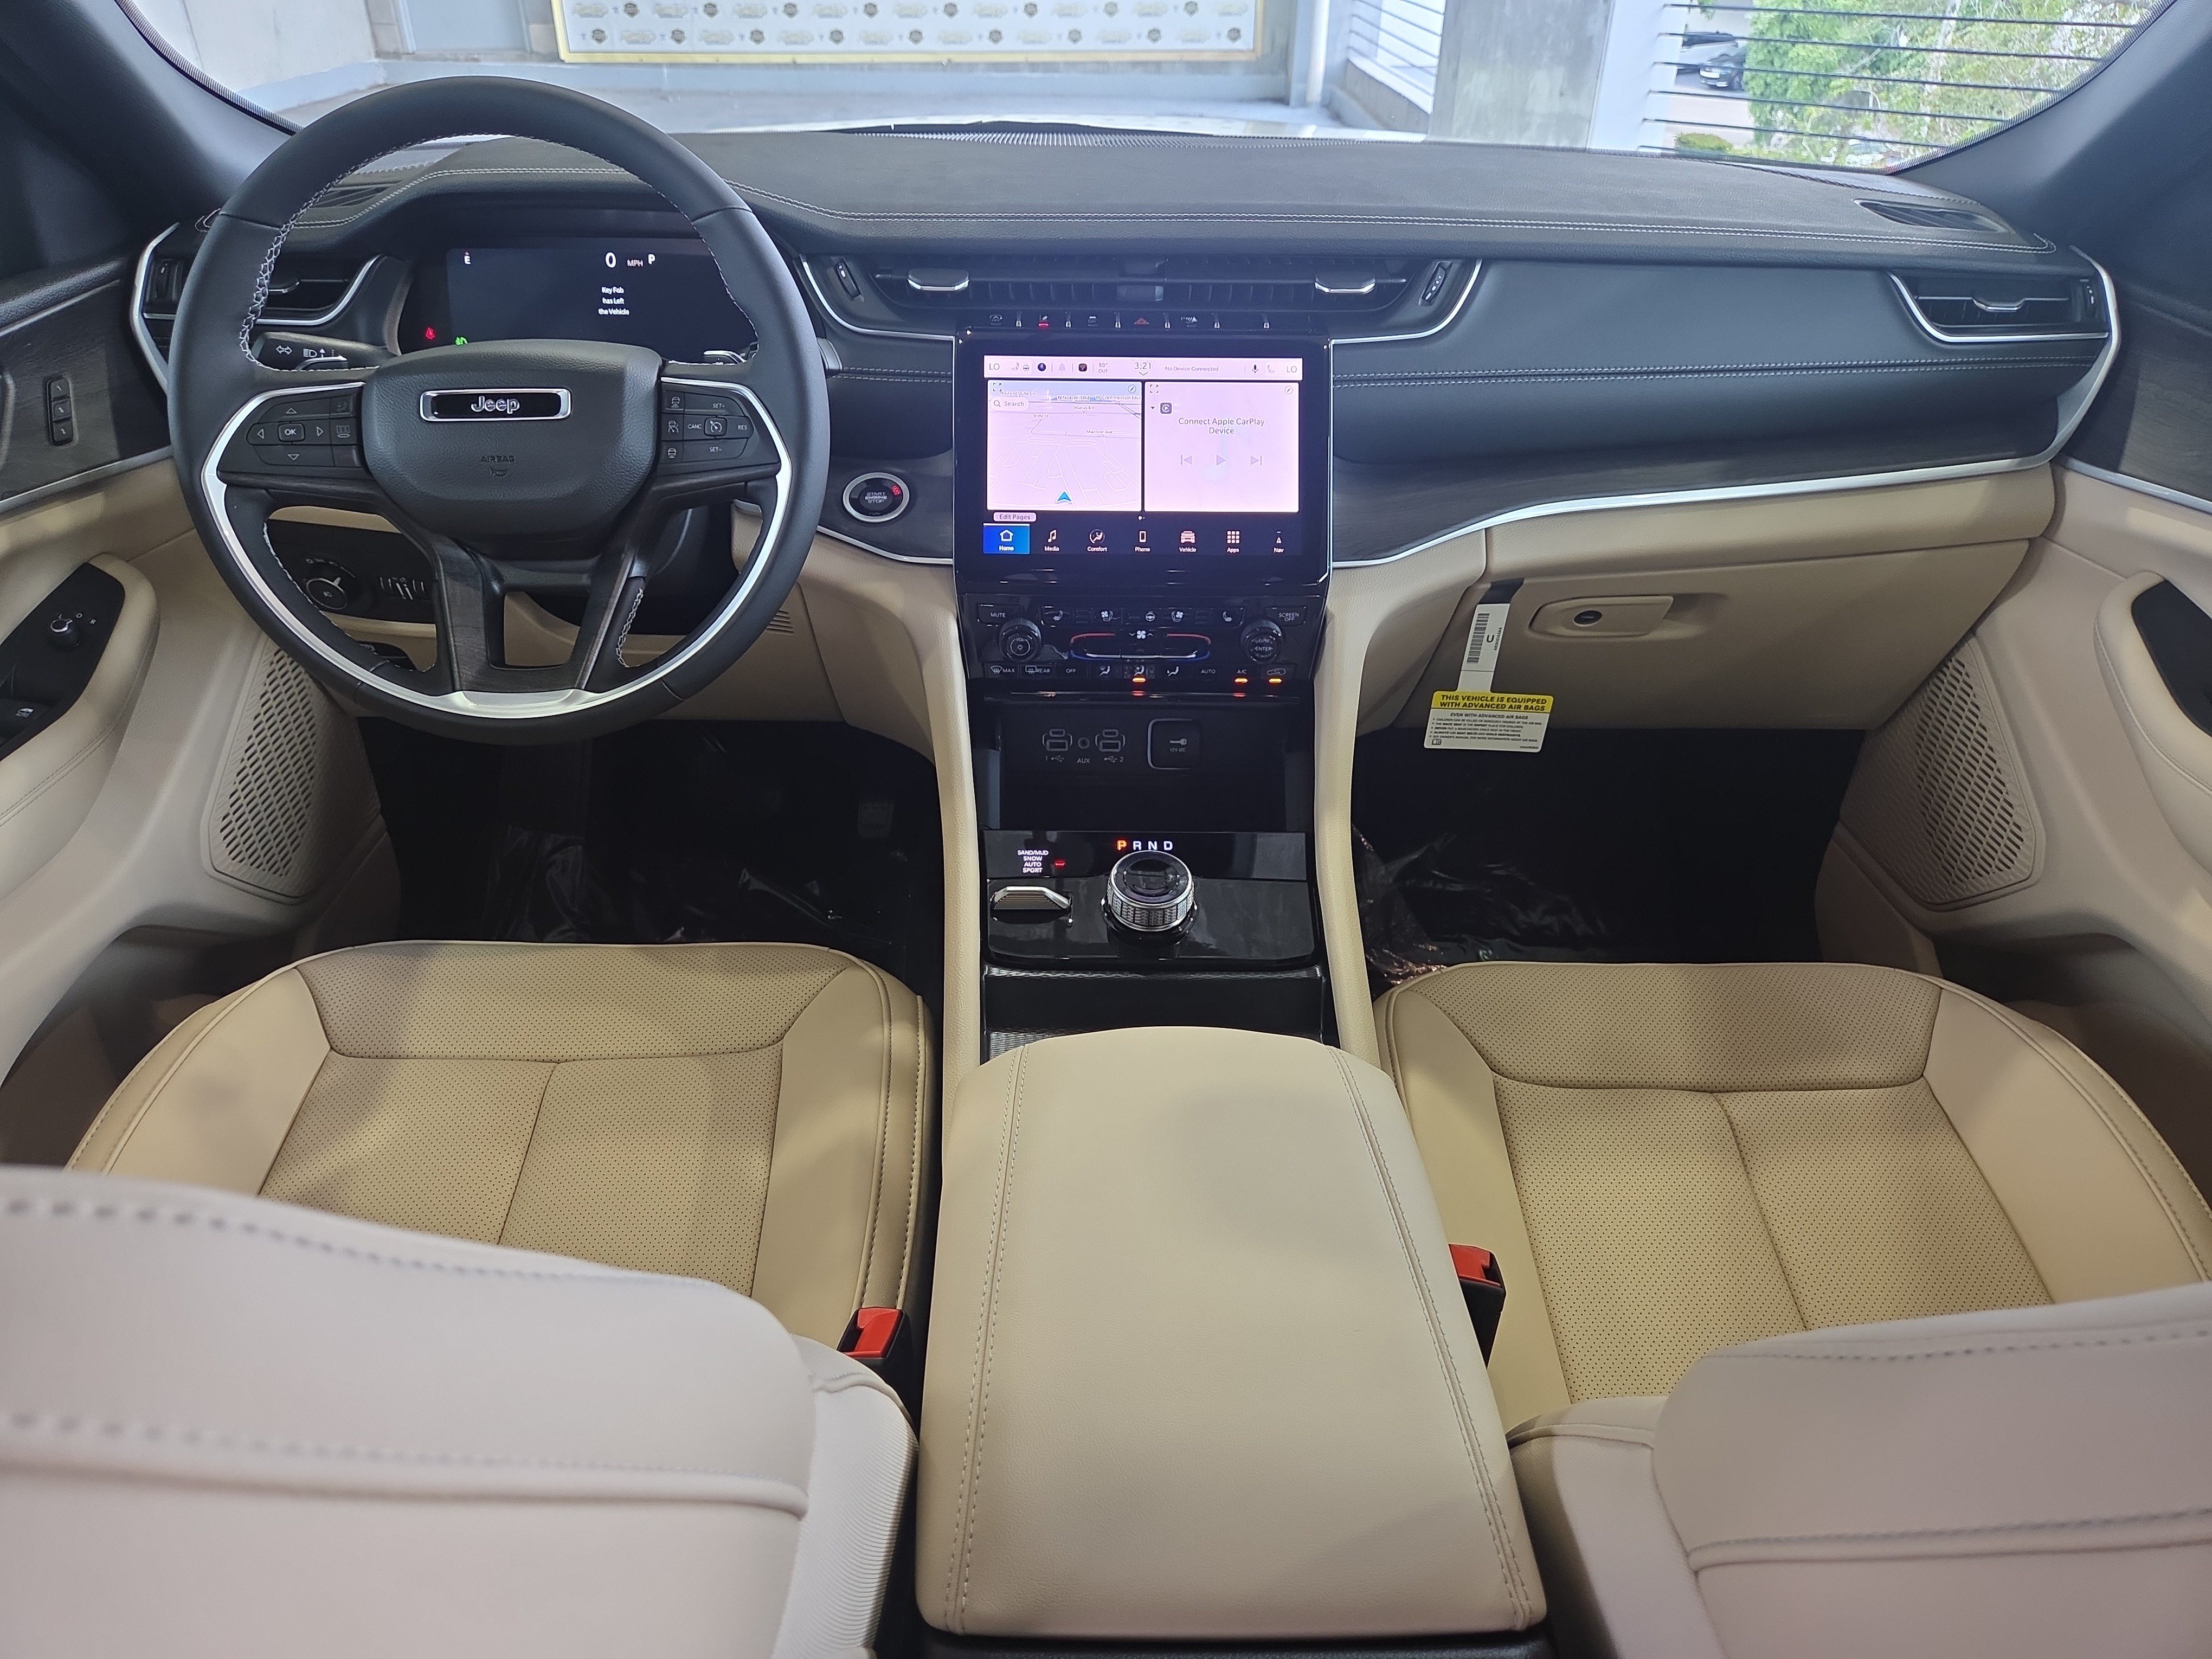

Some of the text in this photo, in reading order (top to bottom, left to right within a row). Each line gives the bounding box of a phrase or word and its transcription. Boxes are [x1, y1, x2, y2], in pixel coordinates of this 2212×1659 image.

[464, 255, 471, 265] E
[605, 252, 616, 268] 0
[648, 254, 655, 265] P
[601, 286, 612, 294] Key
[471, 395, 520, 414] Jeep
[1212, 417, 1234, 426] Apple
[1236, 417, 1265, 427] CarPlay
[1486, 634, 1495, 643] U
[1117, 840, 1173, 851] P R N D
